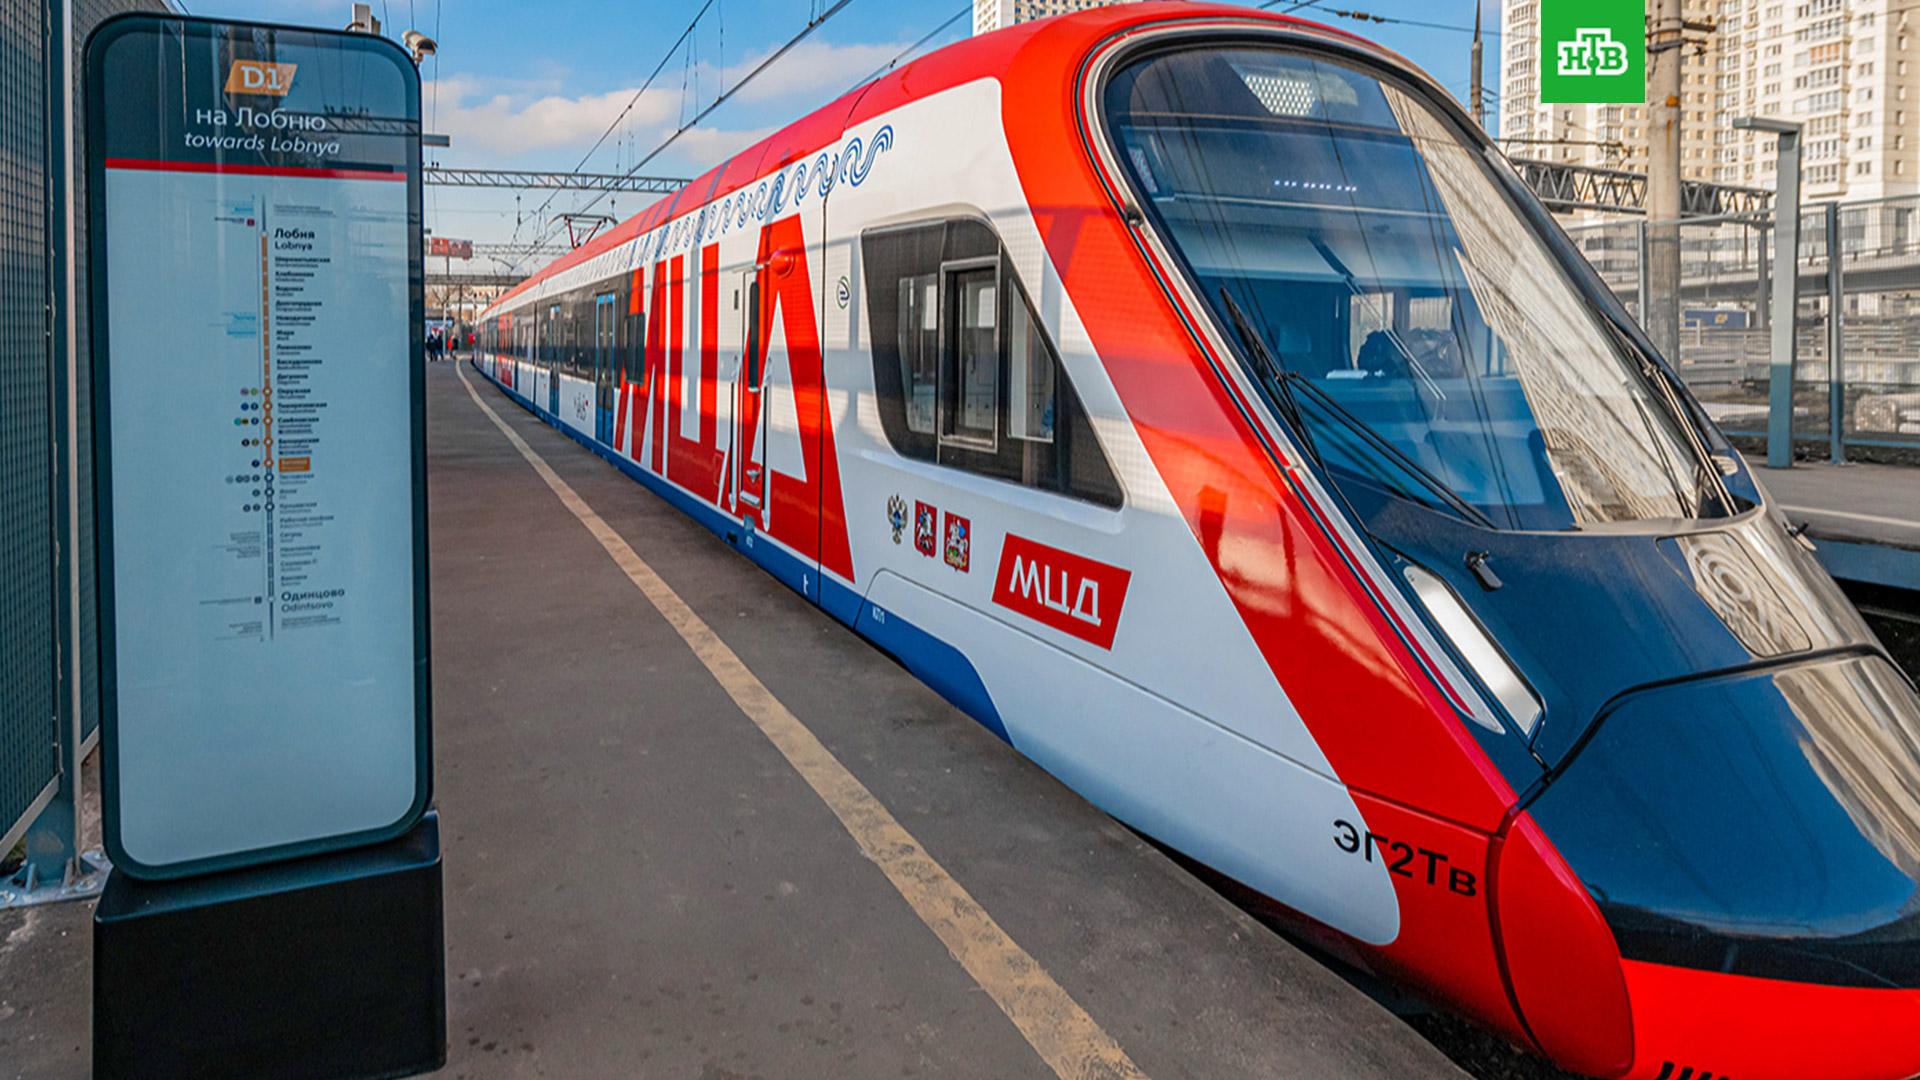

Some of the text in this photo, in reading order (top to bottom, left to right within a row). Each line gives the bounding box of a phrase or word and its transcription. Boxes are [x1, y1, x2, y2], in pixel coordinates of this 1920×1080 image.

[241, 65, 283, 91] D1
[196, 107, 327, 132] на Лобню
[184, 132, 340, 158] towards Lobnya
[274, 228, 315, 240] Лобня
[274, 241, 313, 252] Lobnya
[281, 588, 345, 602] Одинцово
[1009, 554, 1102, 627] МЦД
[281, 601, 334, 613] Odintsovo
